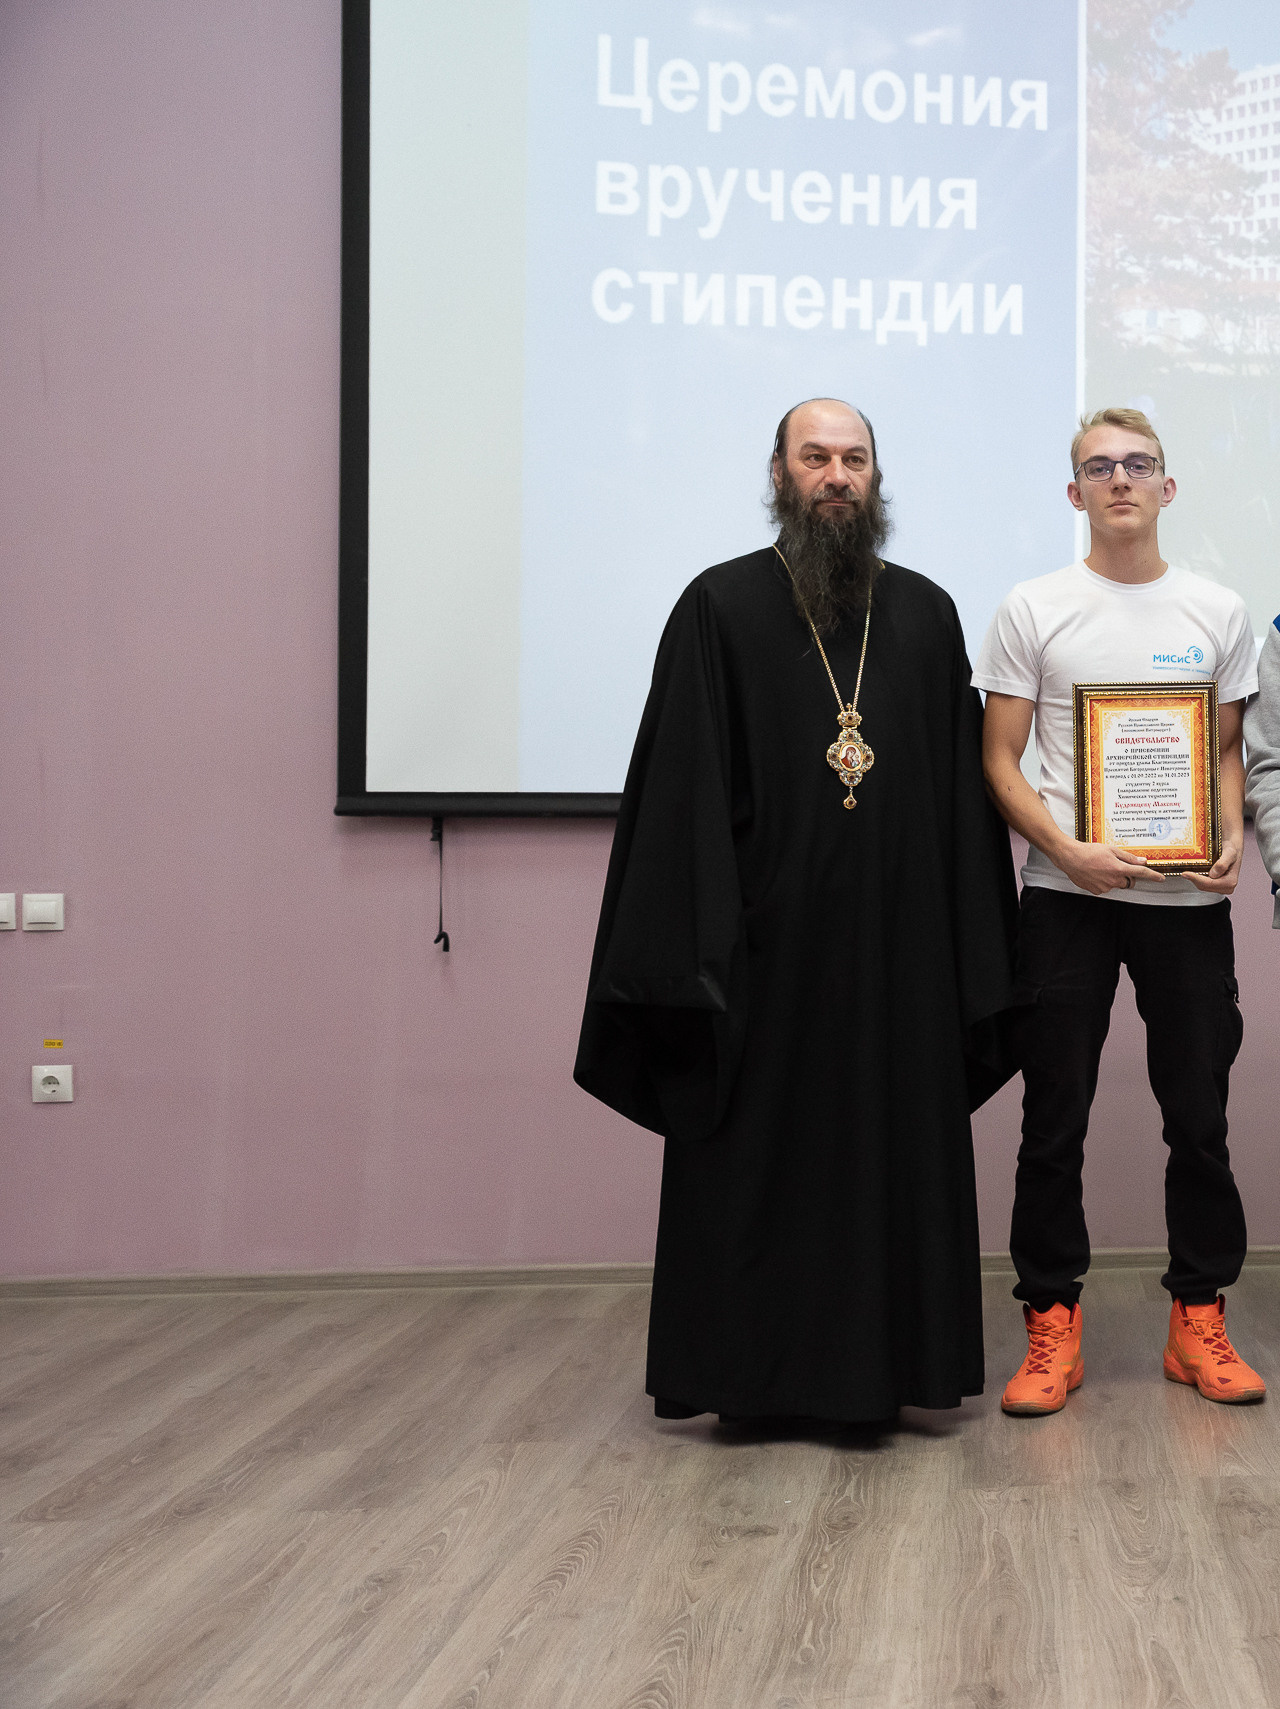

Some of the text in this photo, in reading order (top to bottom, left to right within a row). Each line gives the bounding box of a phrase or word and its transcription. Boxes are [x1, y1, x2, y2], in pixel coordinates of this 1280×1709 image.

[595, 33, 1049, 132] Церемония
[595, 159, 978, 239] вручения
[590, 266, 1024, 347] стипендии
[1153, 654, 1190, 664] МИСиС
[1115, 736, 1180, 745] СВИДЕТЕЛЬСТВО
